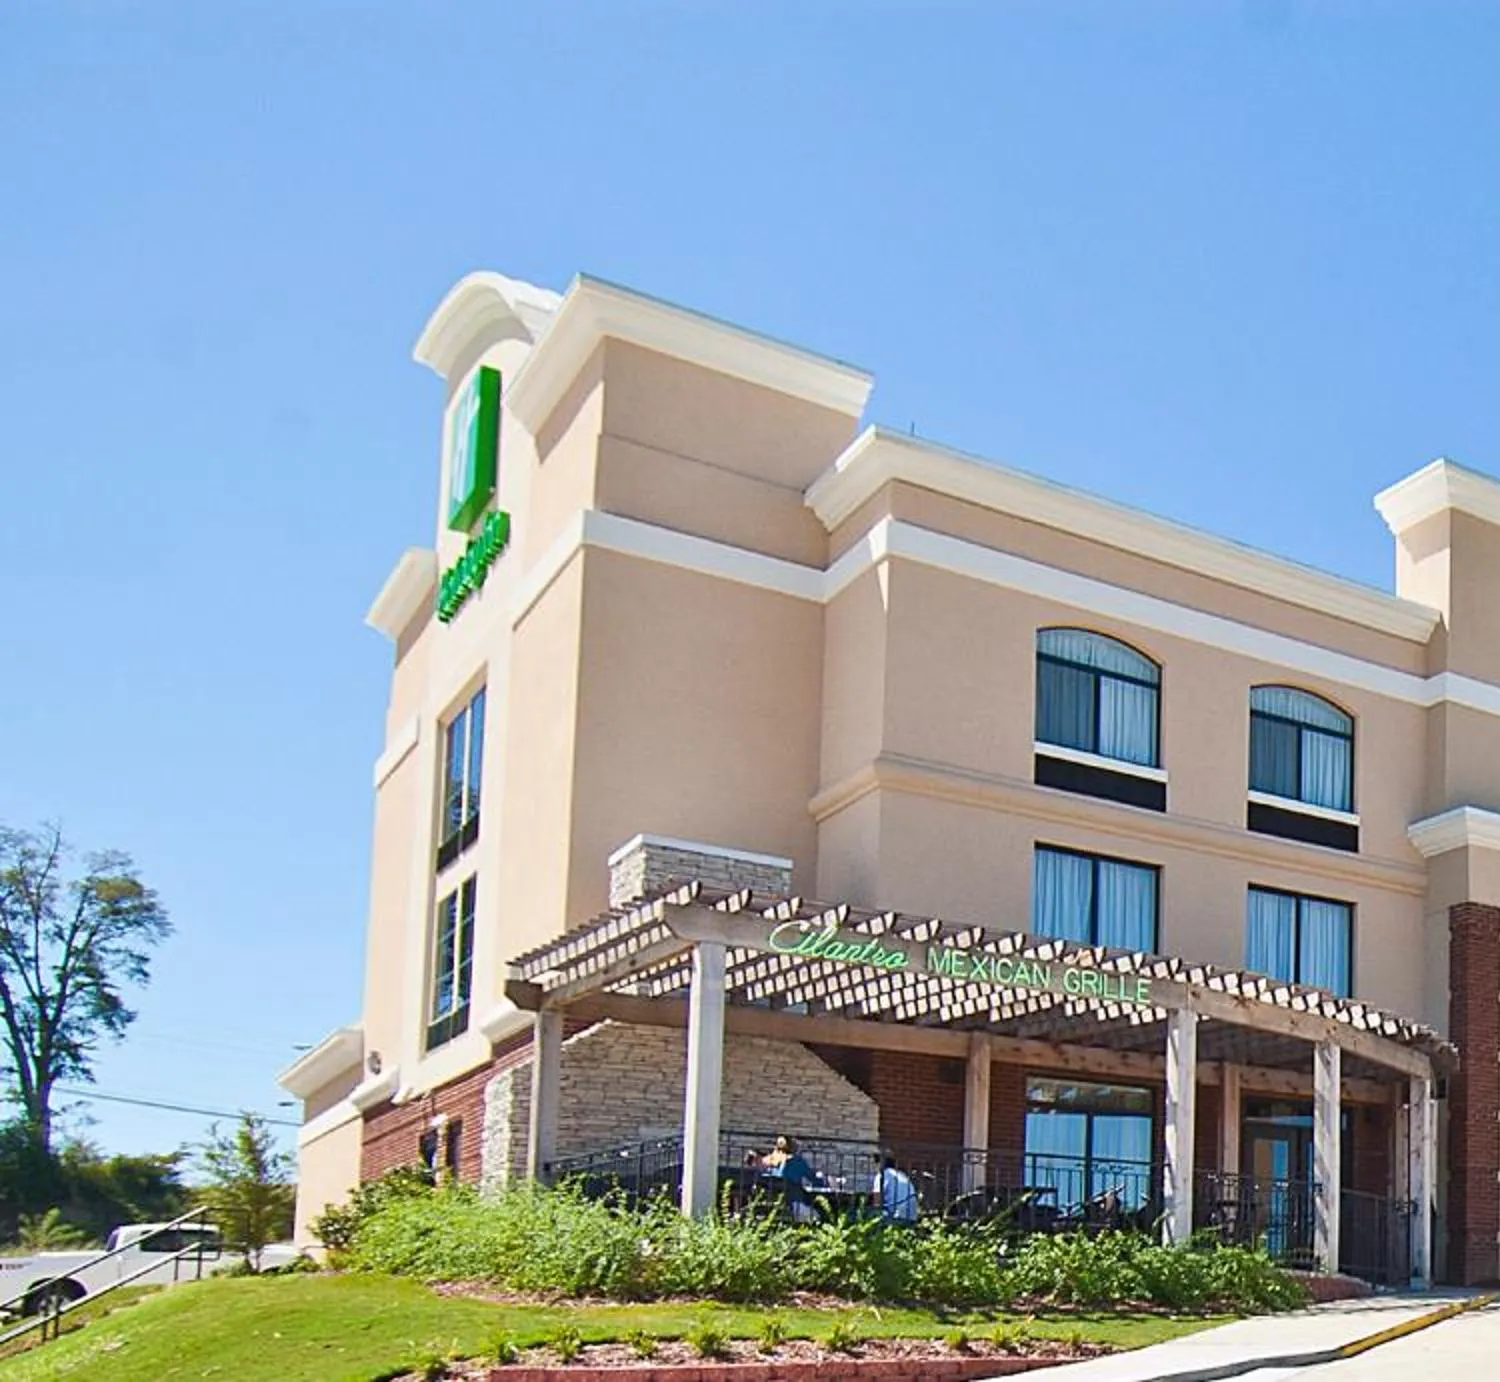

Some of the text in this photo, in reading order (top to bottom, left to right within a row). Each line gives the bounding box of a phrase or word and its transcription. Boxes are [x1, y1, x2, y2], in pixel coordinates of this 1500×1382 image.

[769, 919, 1152, 1004] Cilantro MEXICAN GRILLE
